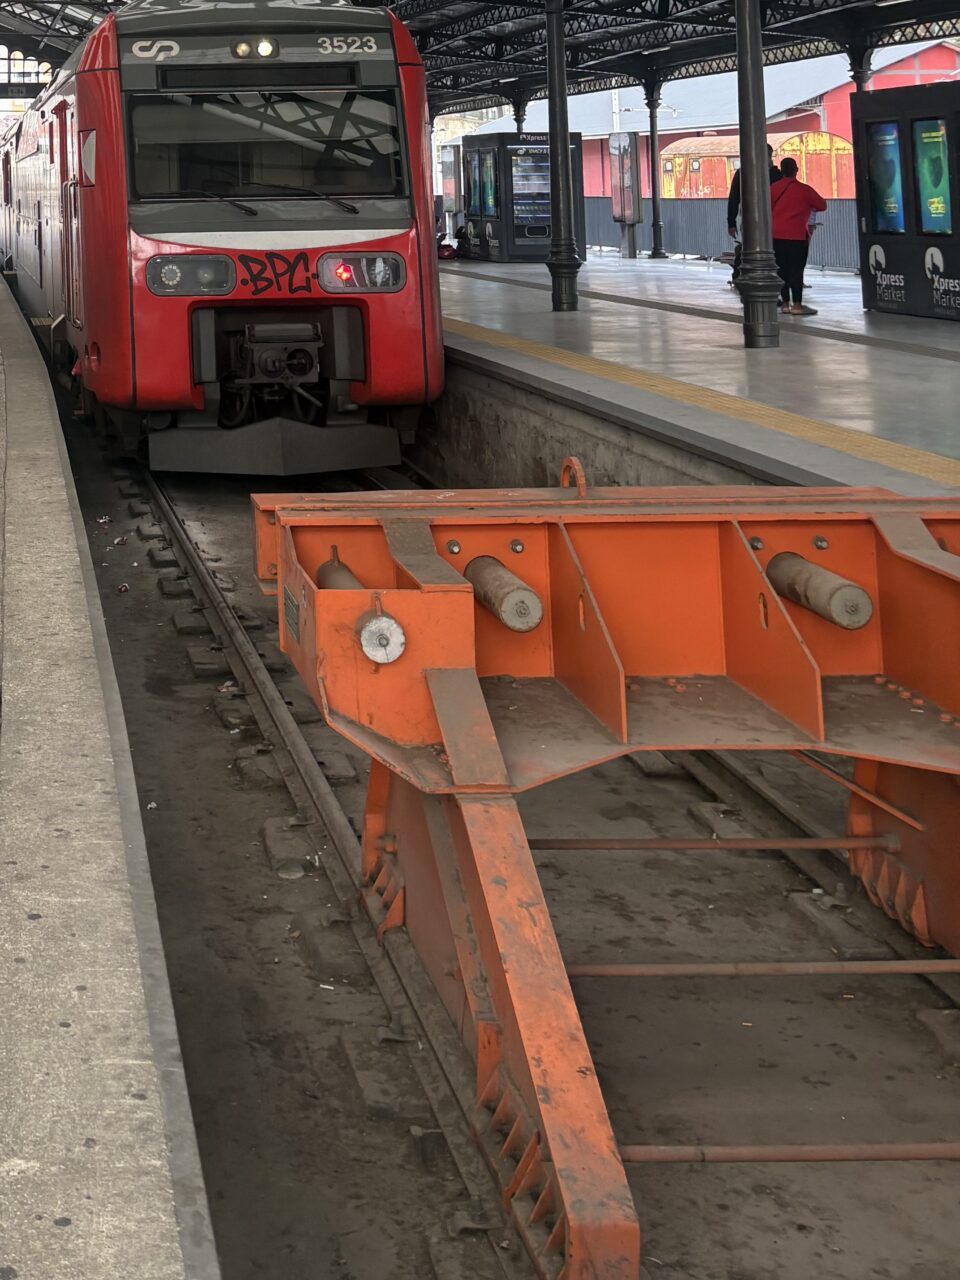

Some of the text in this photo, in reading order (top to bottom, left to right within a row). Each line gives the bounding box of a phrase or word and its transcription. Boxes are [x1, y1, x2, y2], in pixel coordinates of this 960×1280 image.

[317, 36, 378, 55] 3523
[875, 270, 905, 287] Xpress
[932, 274, 960, 293] Xpres
[876, 286, 905, 302] Market
